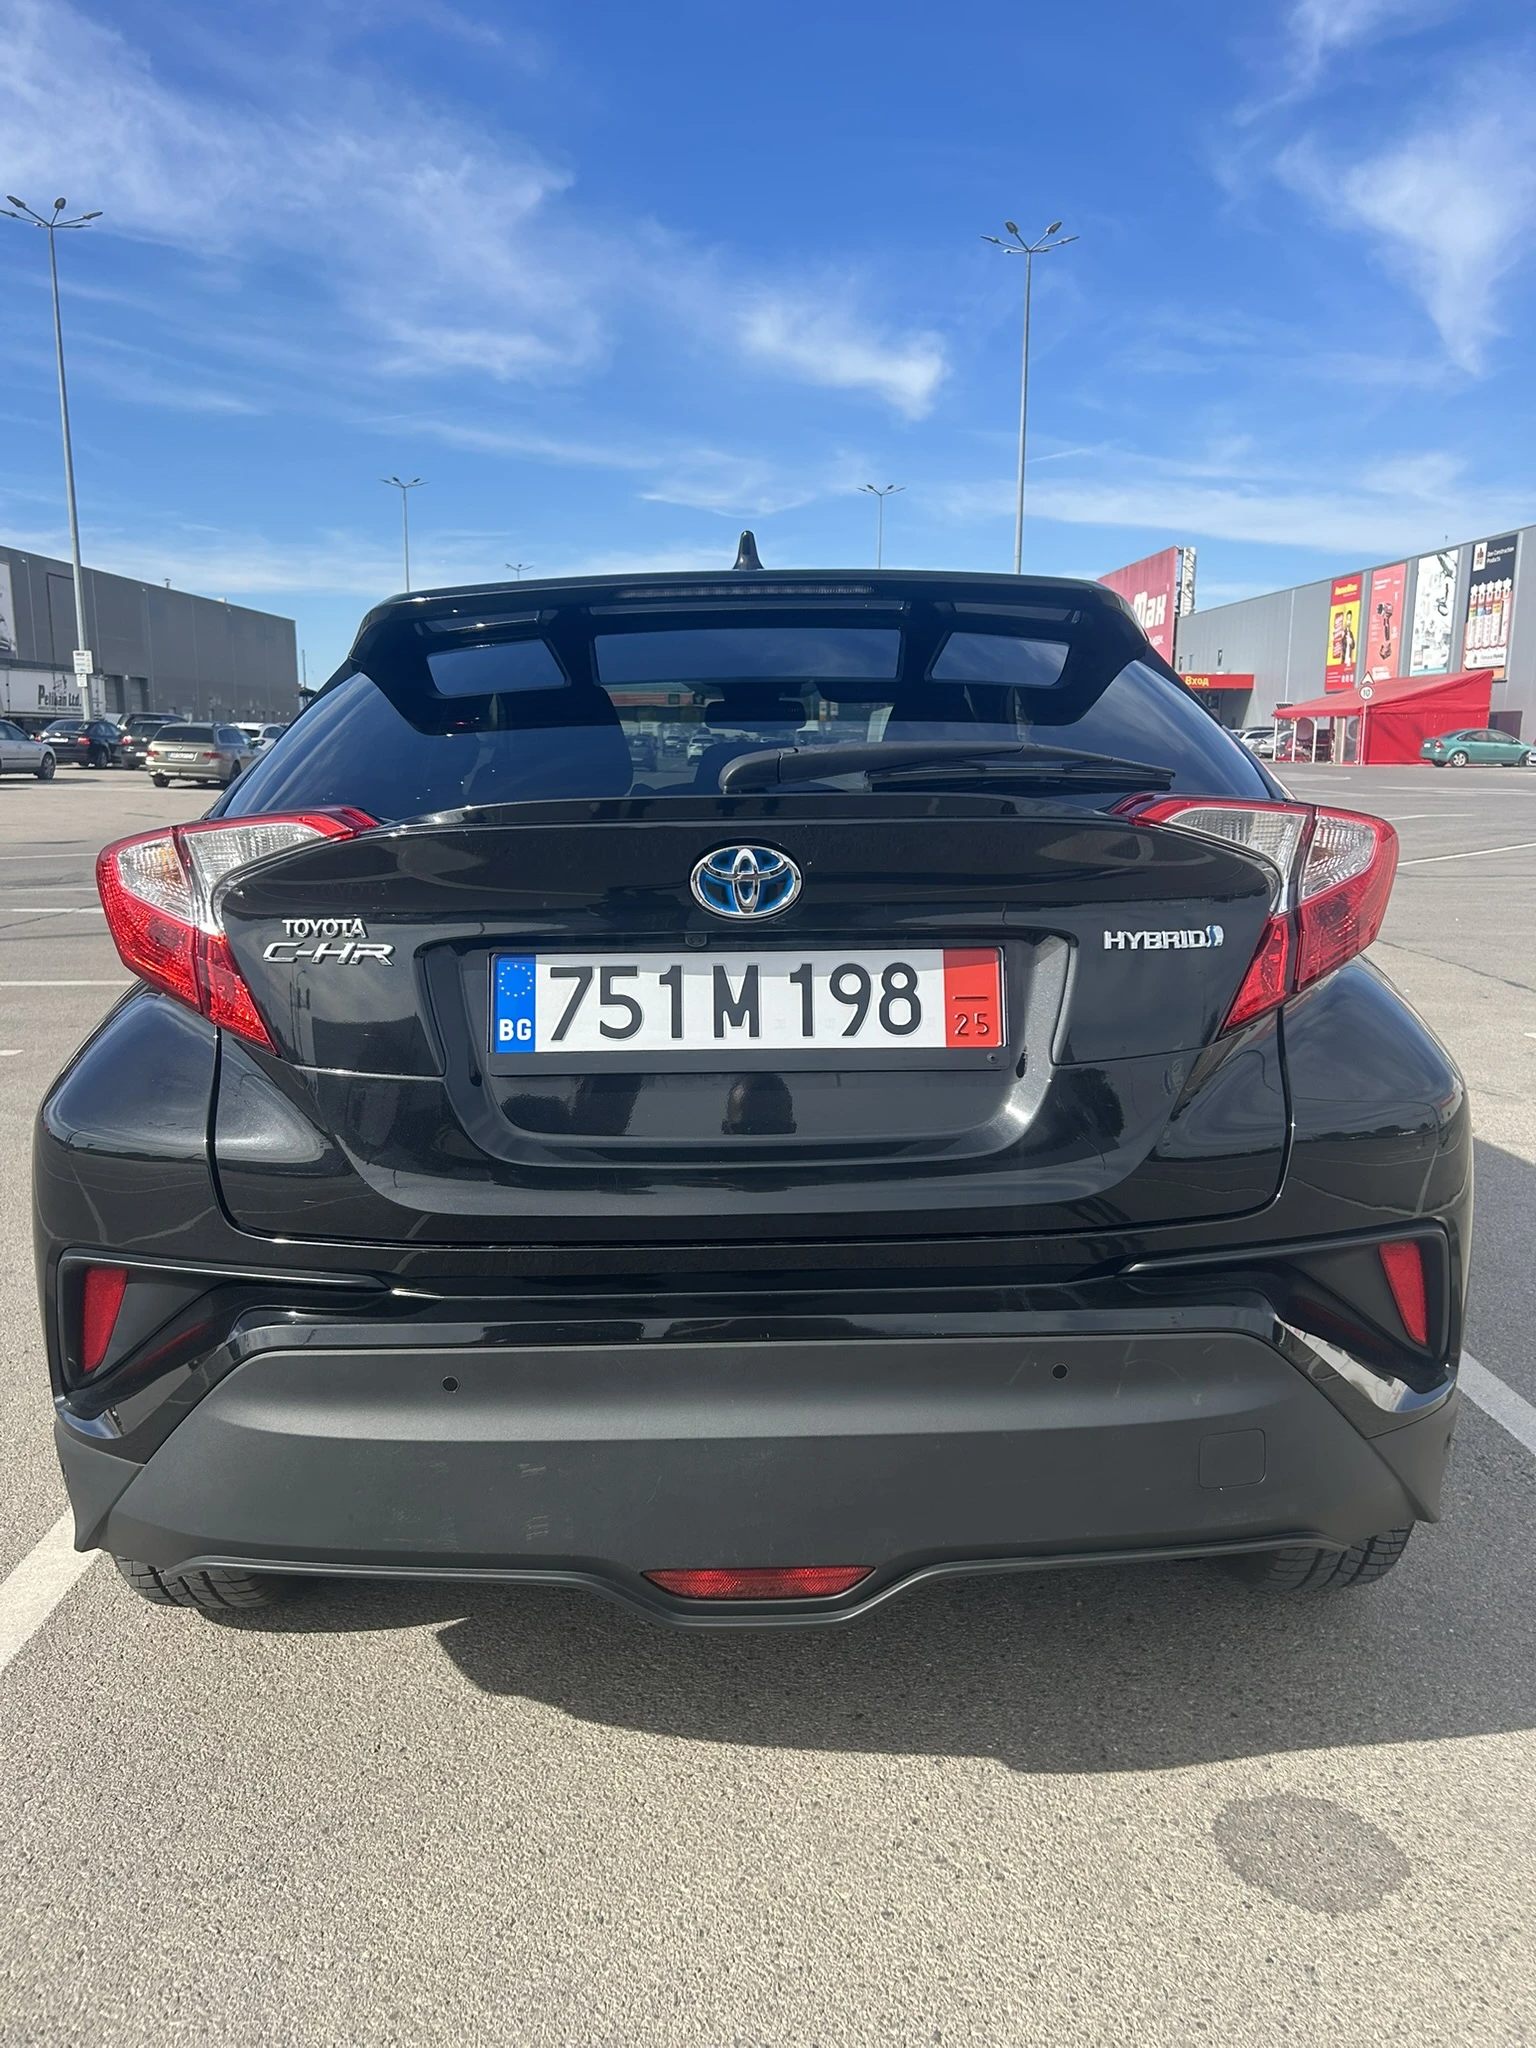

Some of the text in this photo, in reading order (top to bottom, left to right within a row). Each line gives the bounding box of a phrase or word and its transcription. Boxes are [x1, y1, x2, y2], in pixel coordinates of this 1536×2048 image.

[1185, 676, 1209, 687] Вход
[1363, 689, 1370, 697] 10
[38, 684, 82, 707] Pelikan Ltd.
[281, 918, 369, 938] TOYOTA
[1104, 930, 1207, 949] HYBRID
[263, 941, 395, 966] C-HR
[550, 962, 922, 1041] 751 M 198
[499, 1018, 532, 1041] BG
[954, 1012, 990, 1036] 25
